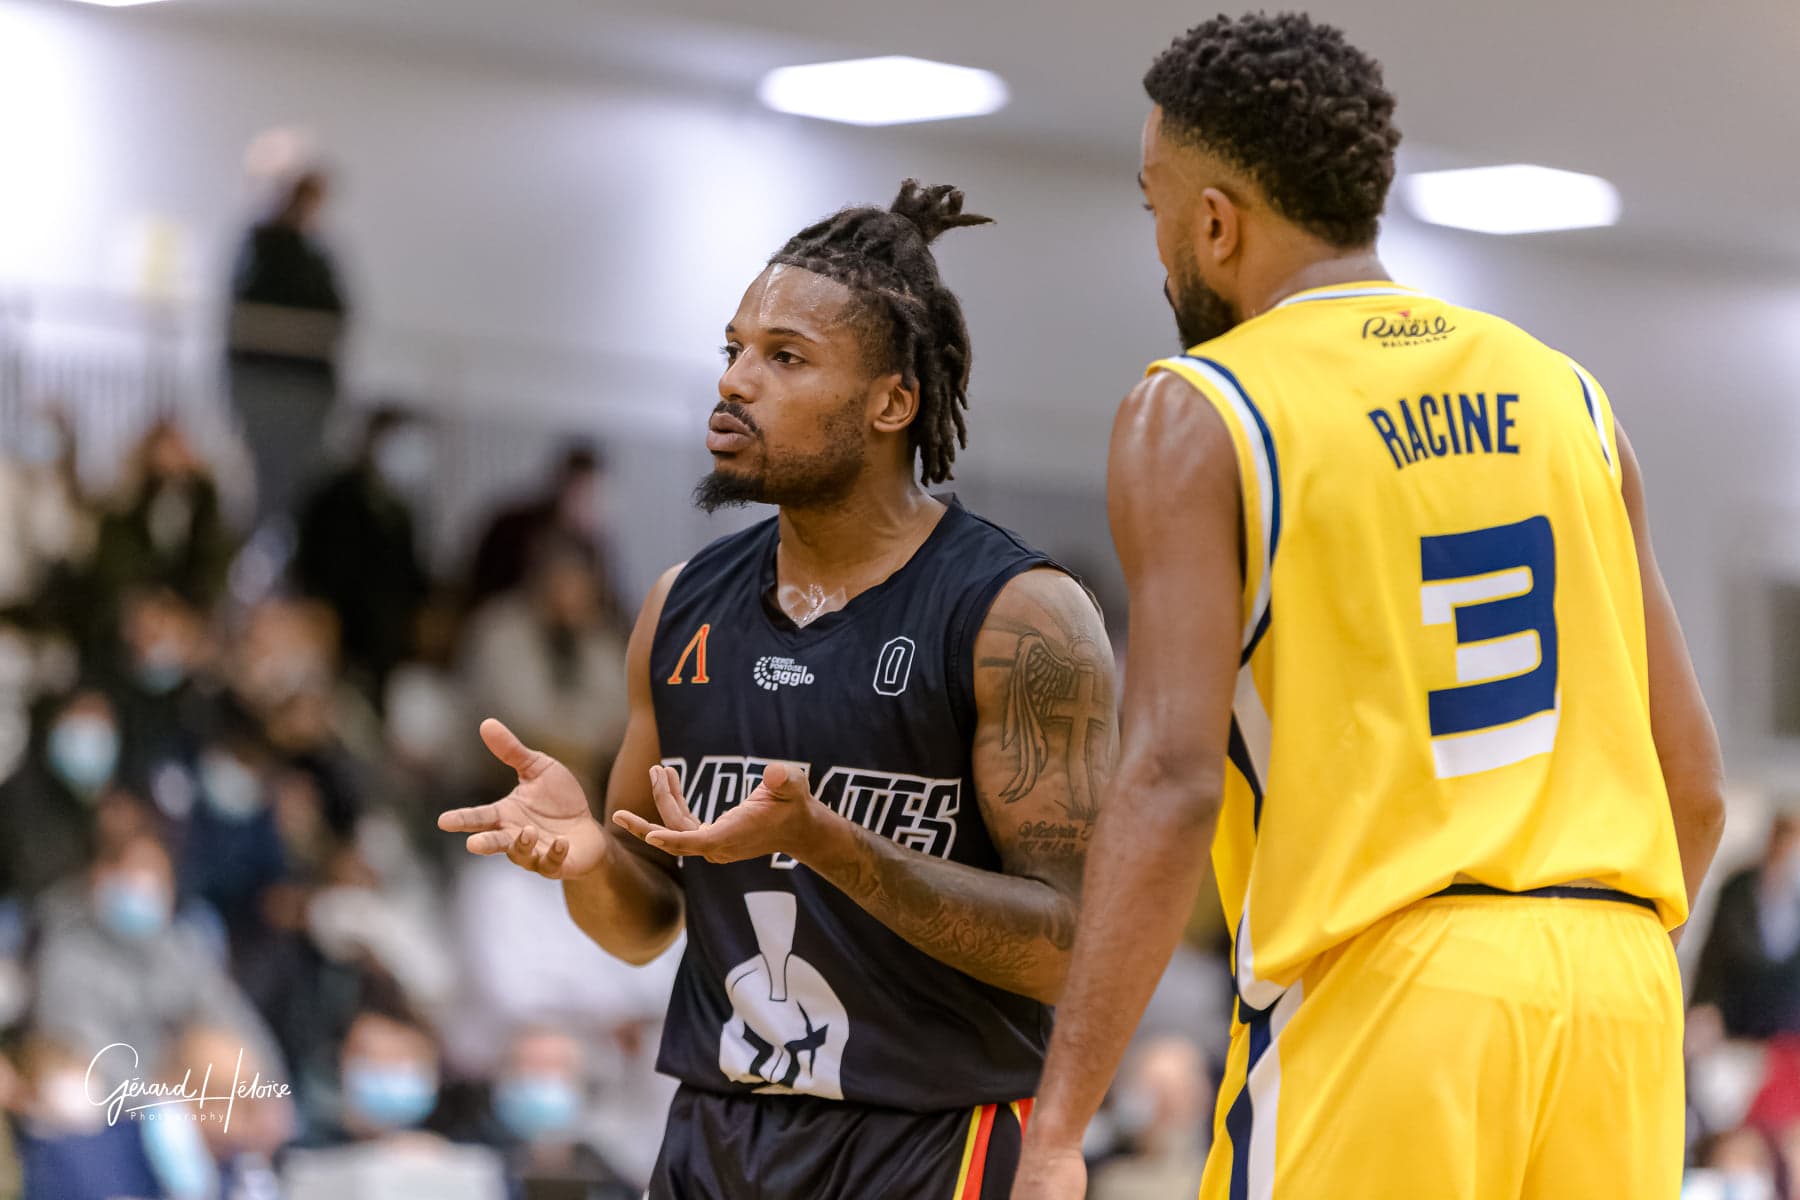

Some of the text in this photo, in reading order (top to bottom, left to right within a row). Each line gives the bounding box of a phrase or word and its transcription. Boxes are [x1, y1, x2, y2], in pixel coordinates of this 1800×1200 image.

[1362, 316, 1456, 339] Rueil
[1367, 392, 1520, 470] RACINE
[772, 665, 815, 687] agglo
[873, 636, 915, 696] 0
[1420, 515, 1560, 779] 3
